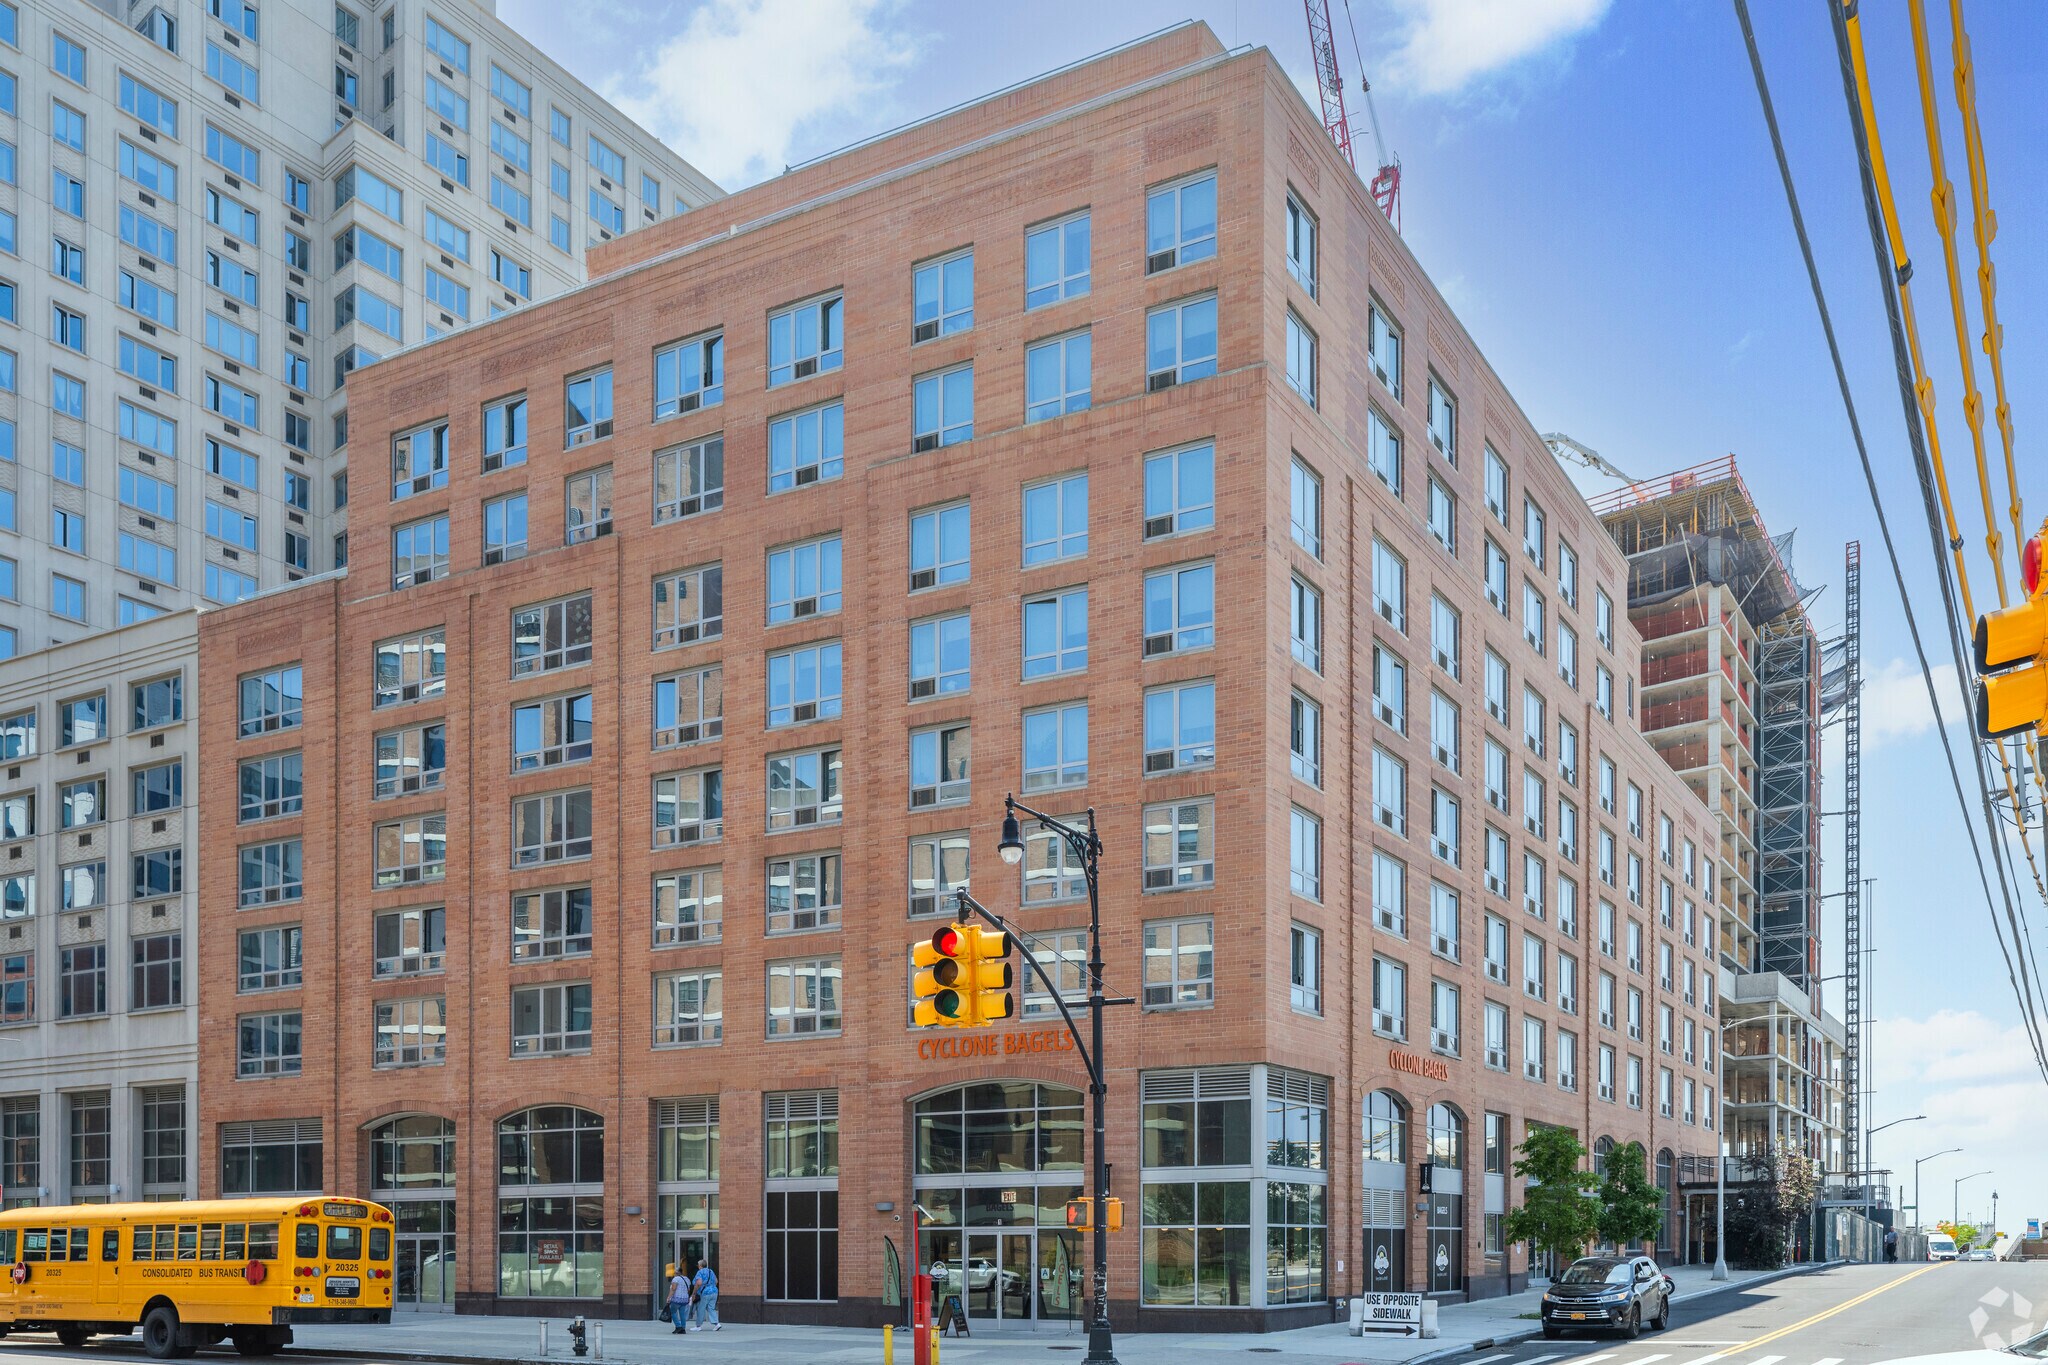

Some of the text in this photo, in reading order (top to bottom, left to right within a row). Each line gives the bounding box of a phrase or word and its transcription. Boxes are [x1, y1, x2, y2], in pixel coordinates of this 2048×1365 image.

[918, 1030, 1074, 1059] CYCLONE BAGELS
[1389, 1049, 1449, 1082] CYCLONE BAGELS
[1003, 1192, 1015, 1201] EXIT
[986, 1202, 1014, 1212] BAGELS
[335, 1263, 359, 1272] 20325
[15, 1269, 25, 1278] STOP
[46, 1269, 62, 1277] 20325
[142, 1268, 193, 1278] CONSOLIDATED
[199, 1268, 214, 1278] BUS
[1366, 1293, 1420, 1307] USE OPPOSITE
[1372, 1307, 1412, 1320] SIDEWALK
